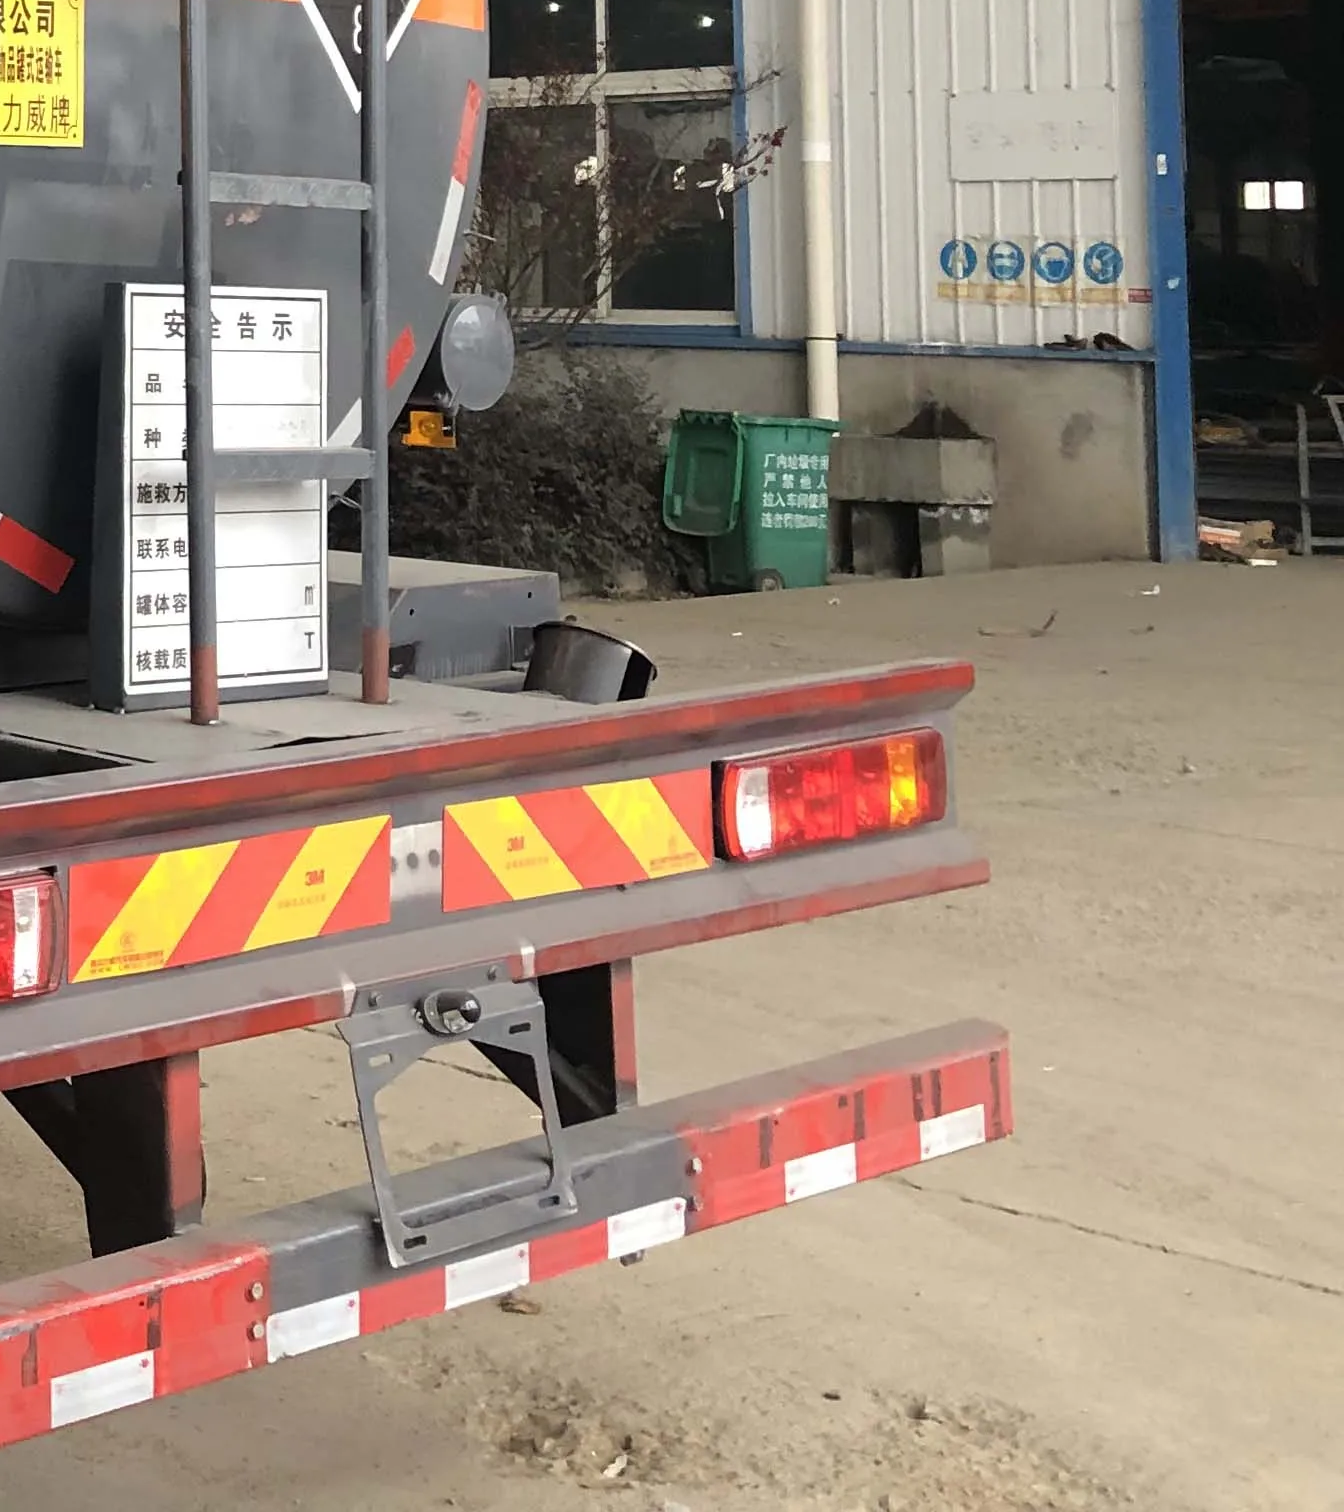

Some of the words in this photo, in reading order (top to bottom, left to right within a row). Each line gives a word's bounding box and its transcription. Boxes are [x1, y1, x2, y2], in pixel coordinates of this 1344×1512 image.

[136, 482, 188, 504] 施救方
[136, 537, 188, 559] 联系电
[136, 593, 188, 616] 罐体容
[136, 647, 188, 672] 核载质
